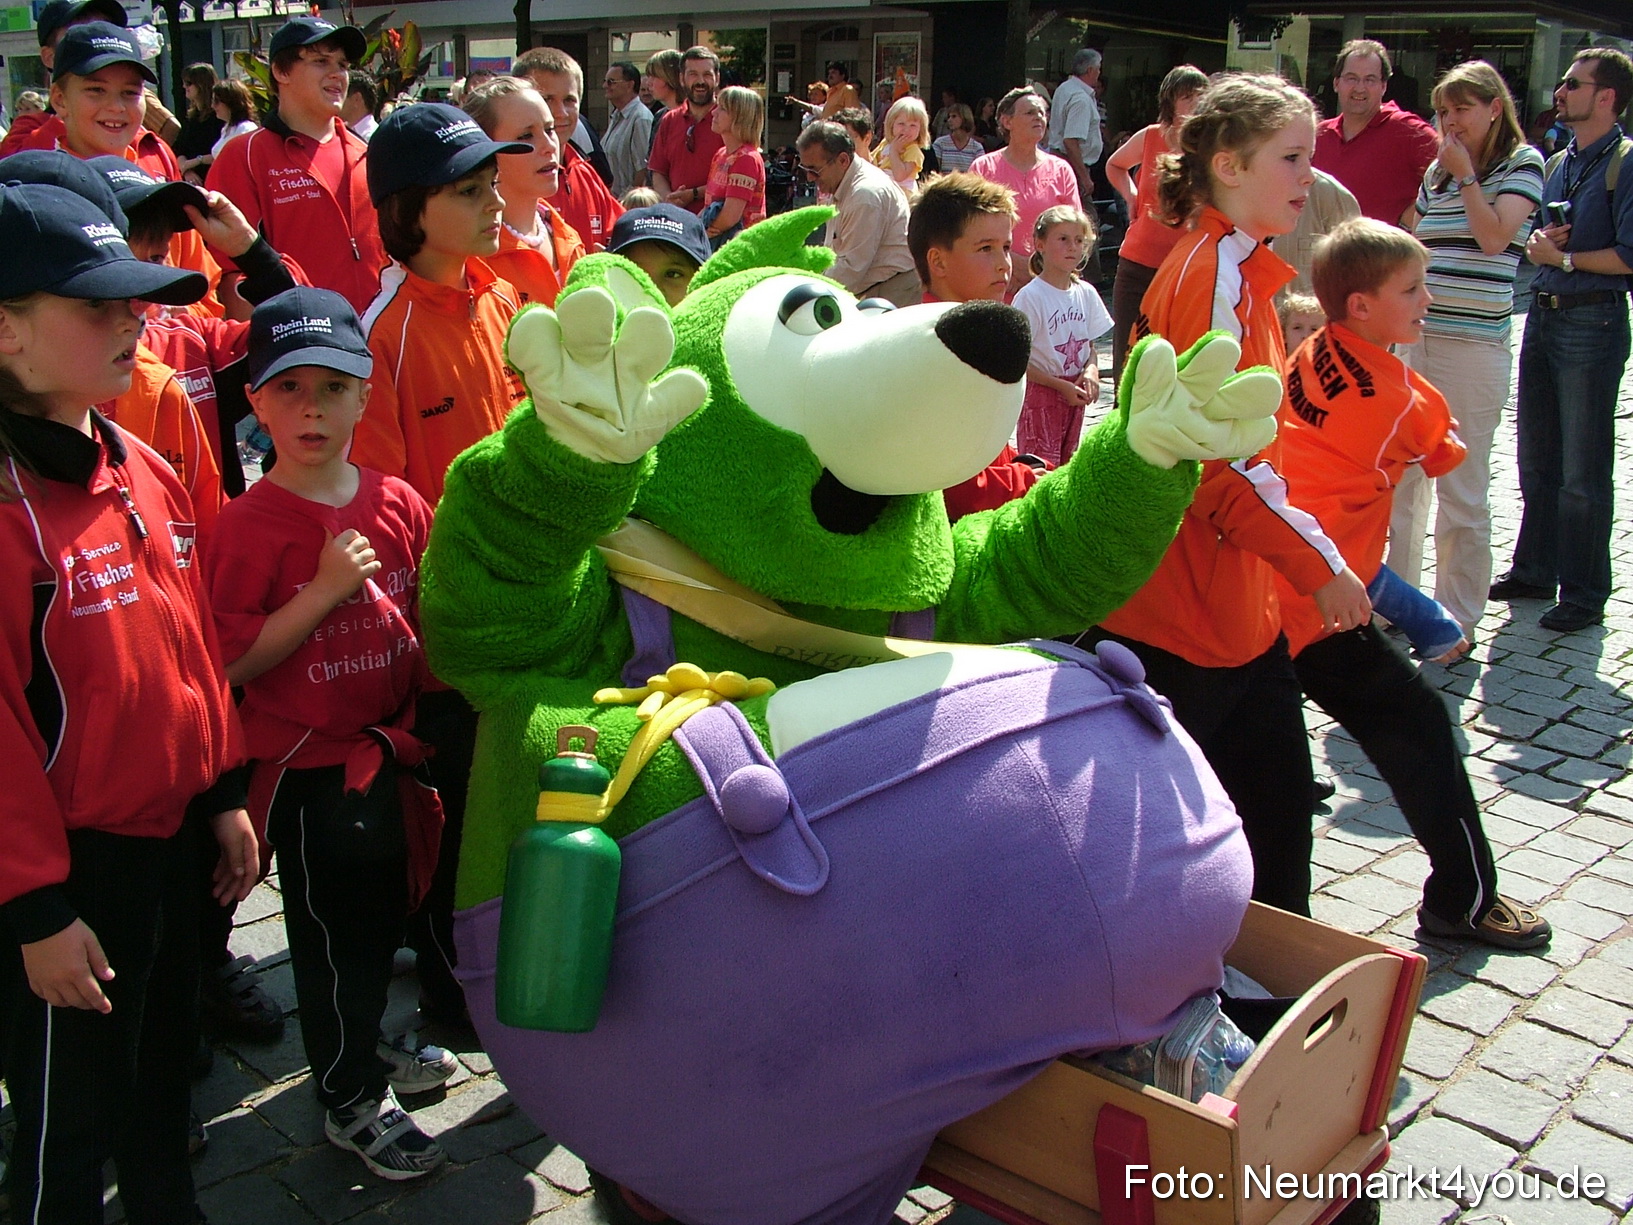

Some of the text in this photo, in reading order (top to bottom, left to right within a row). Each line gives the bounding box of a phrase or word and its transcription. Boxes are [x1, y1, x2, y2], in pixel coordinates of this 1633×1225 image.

[634, 216, 683, 230] RheinLand
[271, 316, 332, 336] RheinLand
[421, 403, 450, 418] JAKO
[76, 563, 134, 592] Fischer
